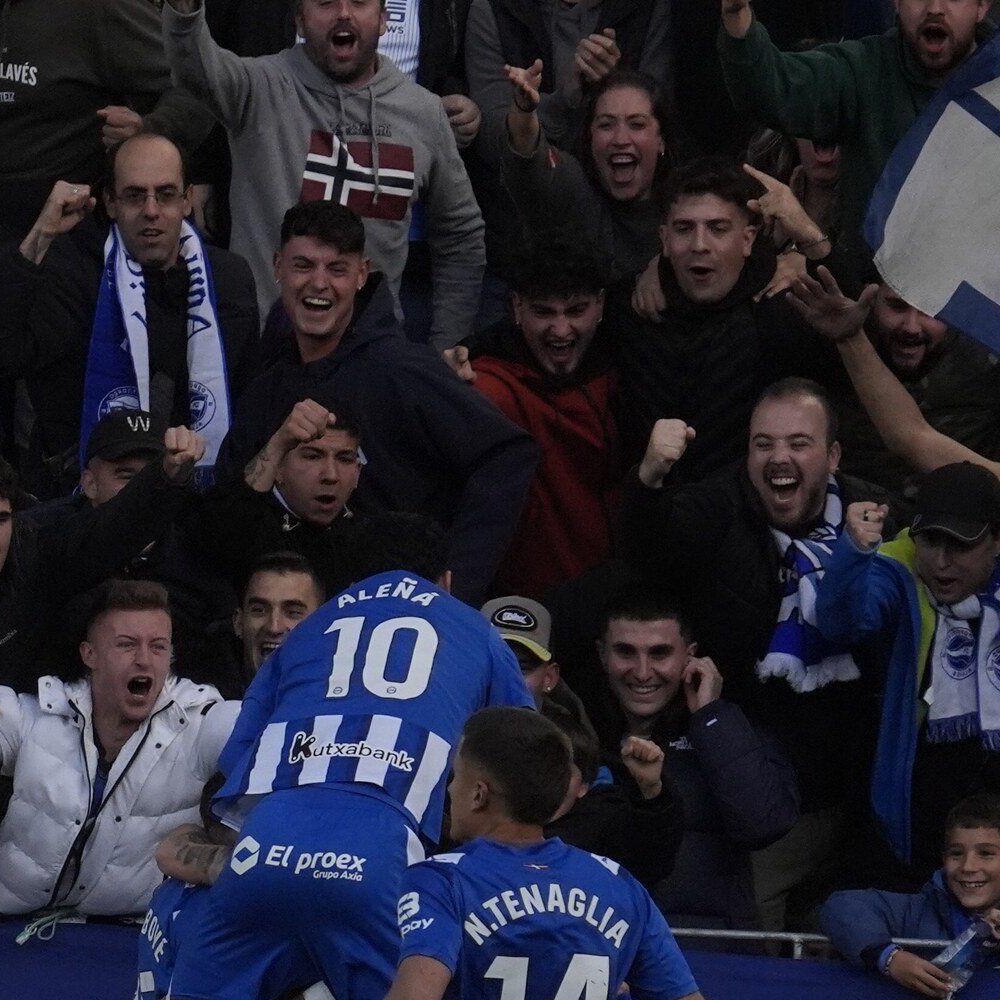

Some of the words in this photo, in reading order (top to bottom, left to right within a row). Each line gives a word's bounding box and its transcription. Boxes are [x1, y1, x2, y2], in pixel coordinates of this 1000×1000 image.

[323, 616, 439, 700] 10
[290, 732, 415, 771] Kutxabank
[265, 845, 294, 867] El
[295, 851, 366, 875] proex
[313, 870, 340, 880] Grupo
[464, 884, 630, 949] N.TENAGLIA
